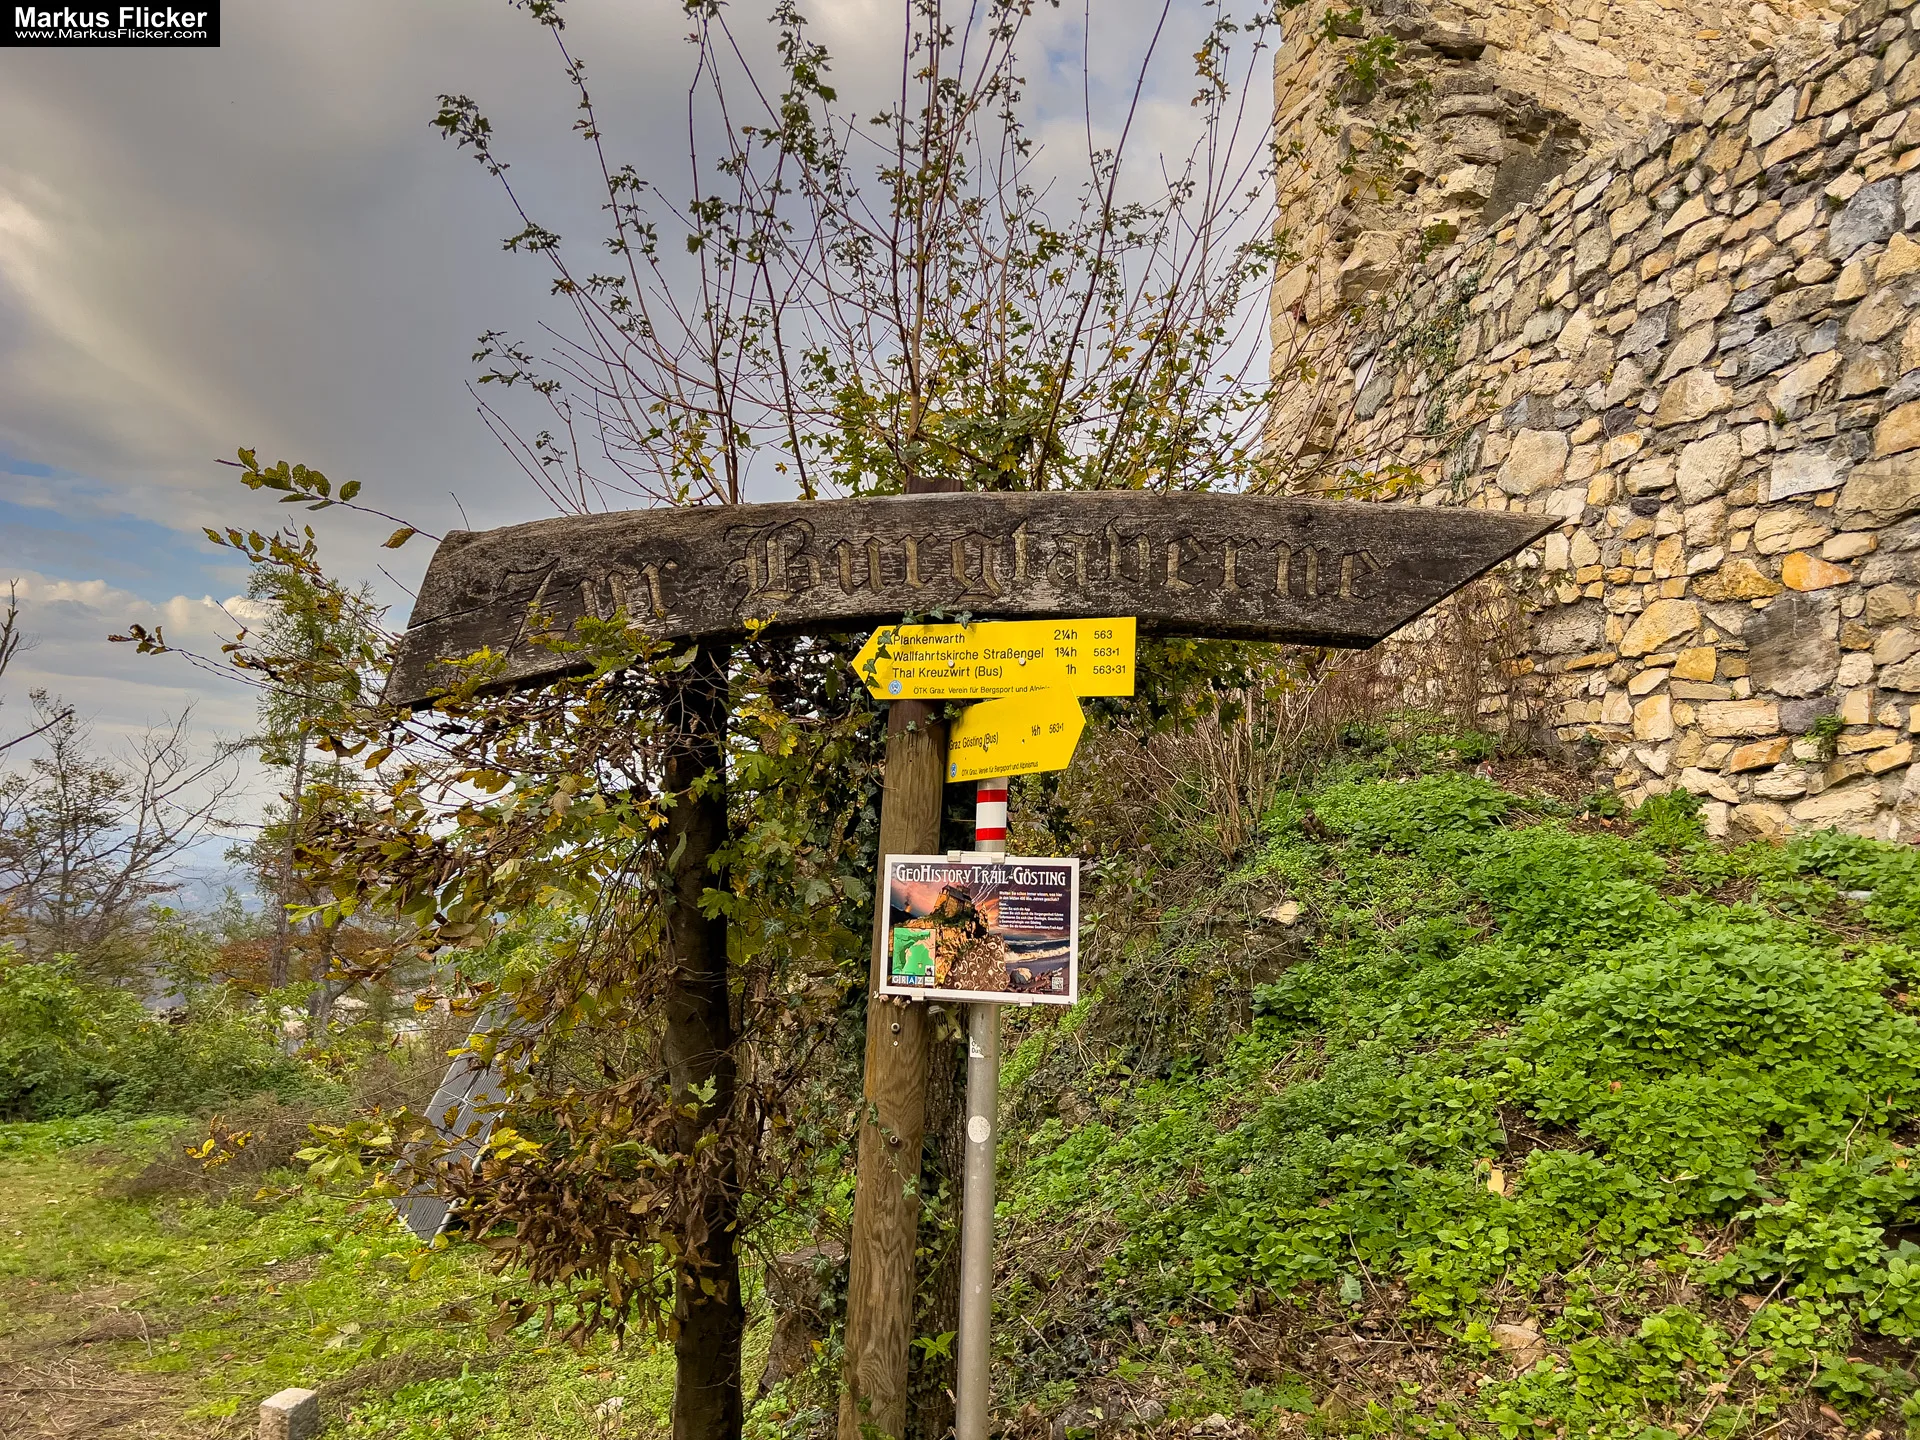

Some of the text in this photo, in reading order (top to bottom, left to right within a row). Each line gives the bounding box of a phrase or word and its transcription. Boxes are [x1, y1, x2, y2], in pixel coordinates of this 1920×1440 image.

[723, 517, 1382, 615] Burgtaverne
[893, 633, 965, 645] Plankenwarth
[1094, 630, 1112, 639] 563
[893, 649, 979, 661] Wallfahrtskirche
[983, 648, 1044, 660] Straßengel
[892, 668, 915, 678] Thal
[918, 667, 970, 678] Kreuzwirt
[974, 666, 1003, 679] (Bus)
[1066, 664, 1077, 674] 1h
[980, 686, 1014, 694] Bergsport
[948, 731, 998, 751] Graz Gösting (Bus)
